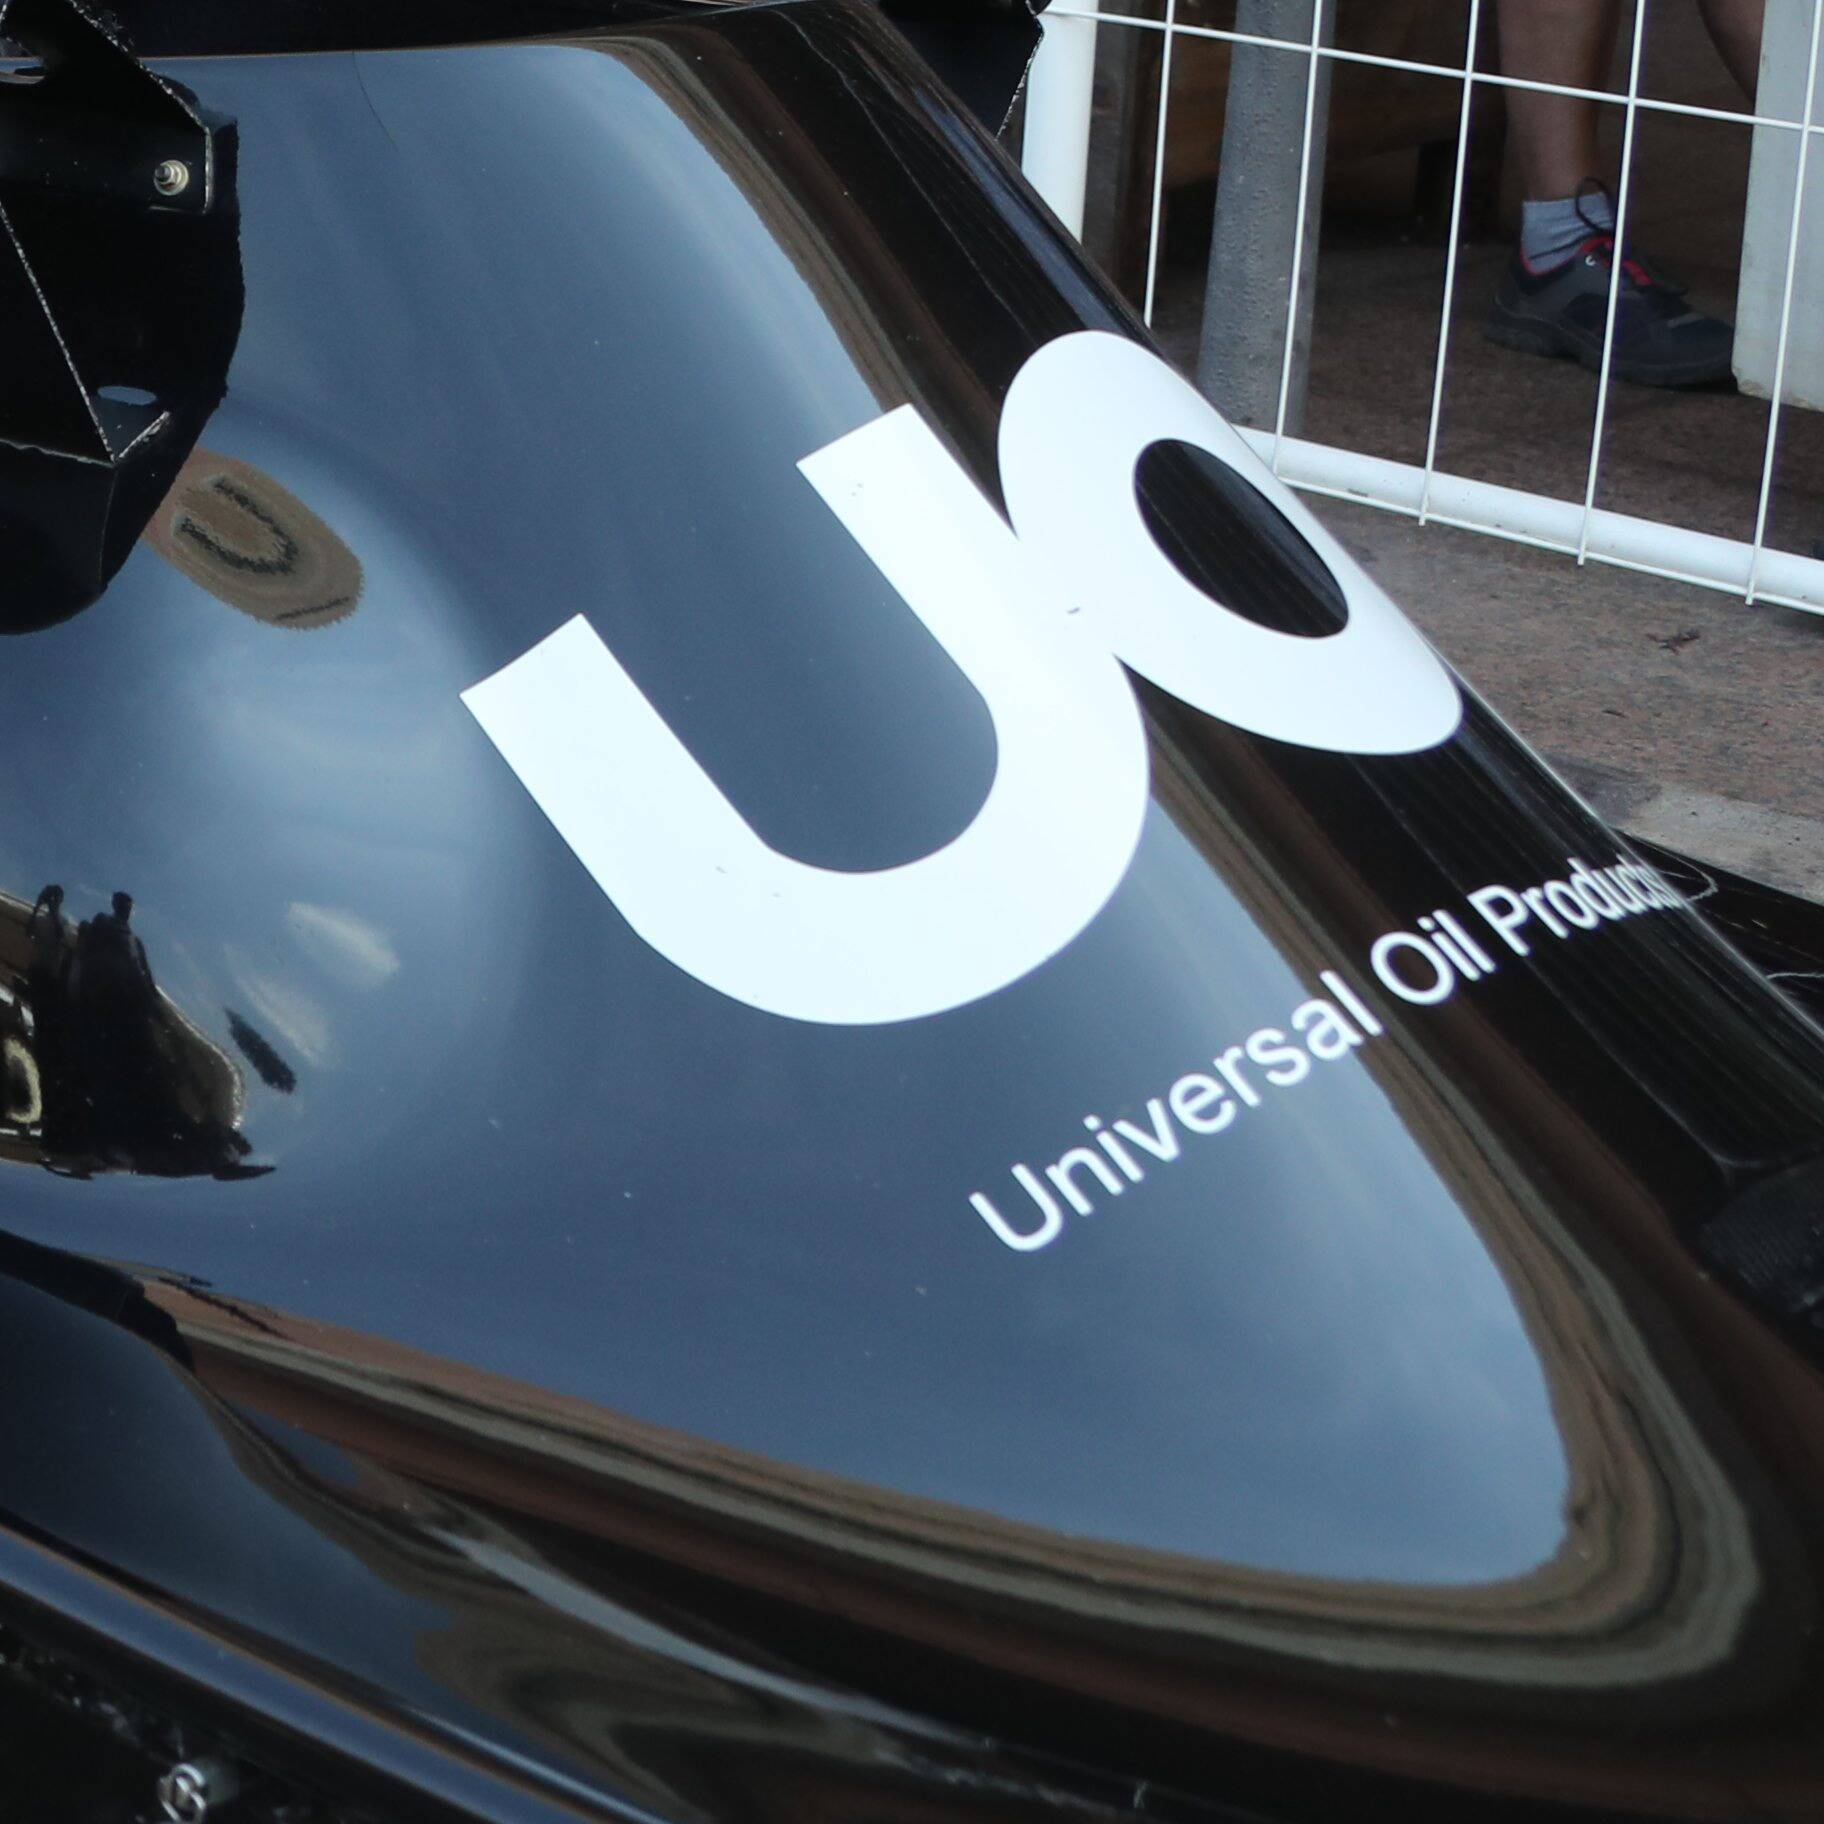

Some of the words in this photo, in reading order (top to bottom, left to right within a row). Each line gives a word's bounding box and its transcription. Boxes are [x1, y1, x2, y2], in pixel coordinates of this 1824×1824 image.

[459, 329, 1462, 1026] uo
[967, 970, 1384, 1254] Universal
[1369, 908, 1497, 1007] Oil
